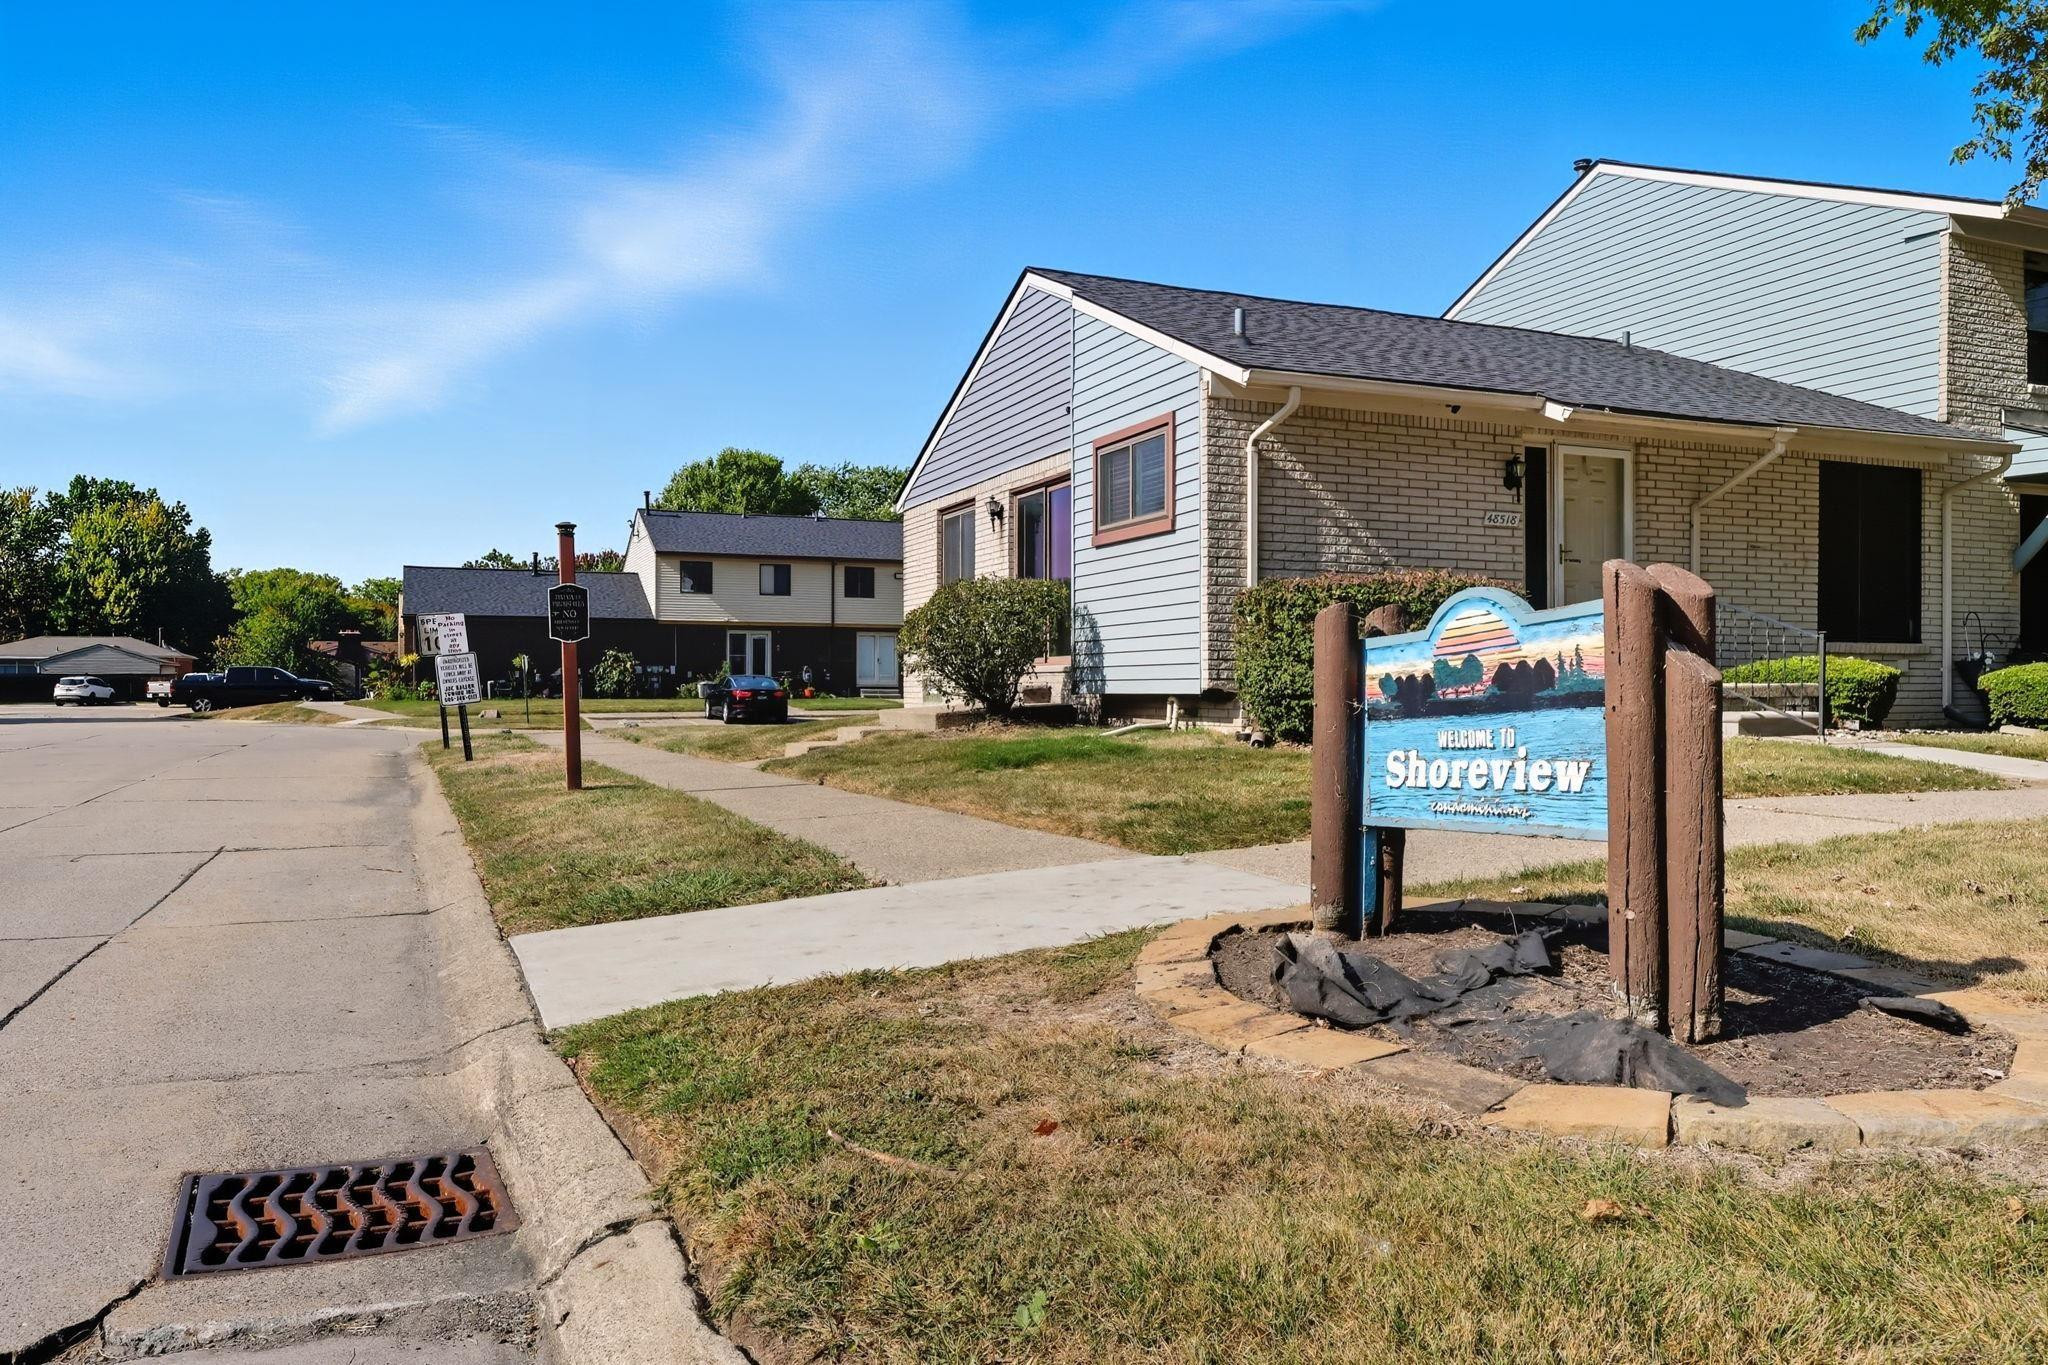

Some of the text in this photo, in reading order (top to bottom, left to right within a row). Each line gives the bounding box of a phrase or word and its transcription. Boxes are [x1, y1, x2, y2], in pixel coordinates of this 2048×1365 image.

[1487, 514, 1517, 525] 48518
[563, 610, 577, 618] NO
[420, 618, 437, 626] SPE
[1438, 727, 1516, 749] WELCOME TO
[1386, 746, 1591, 793] Shoreview
